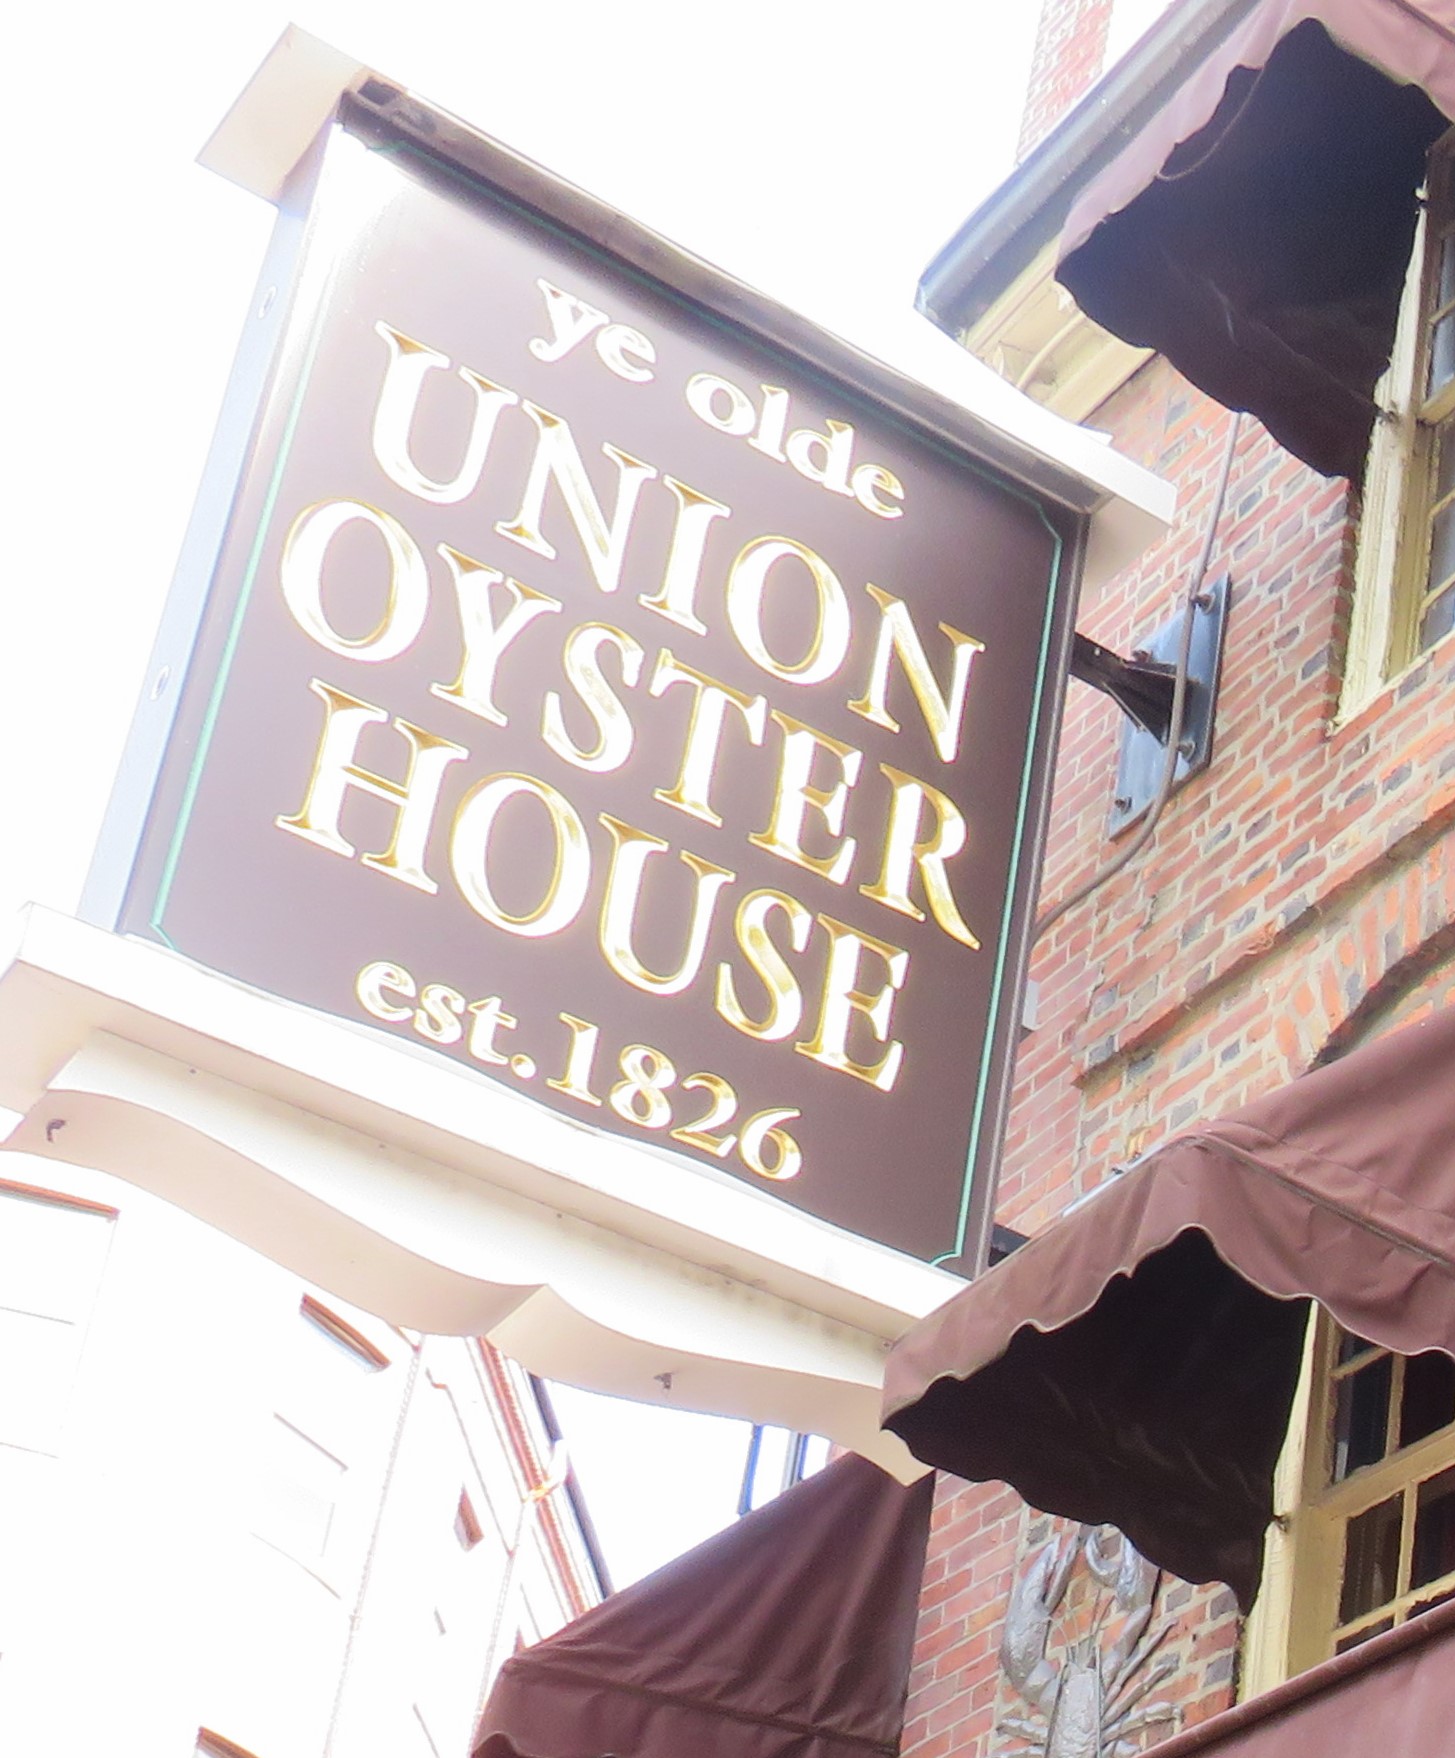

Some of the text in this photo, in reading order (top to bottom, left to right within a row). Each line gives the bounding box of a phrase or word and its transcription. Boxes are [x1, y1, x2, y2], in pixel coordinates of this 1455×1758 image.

[370, 320, 986, 765] UNION
[527, 277, 906, 520] ye olde
[275, 677, 910, 1092] HOUSE
[280, 496, 981, 950] OYSTER
